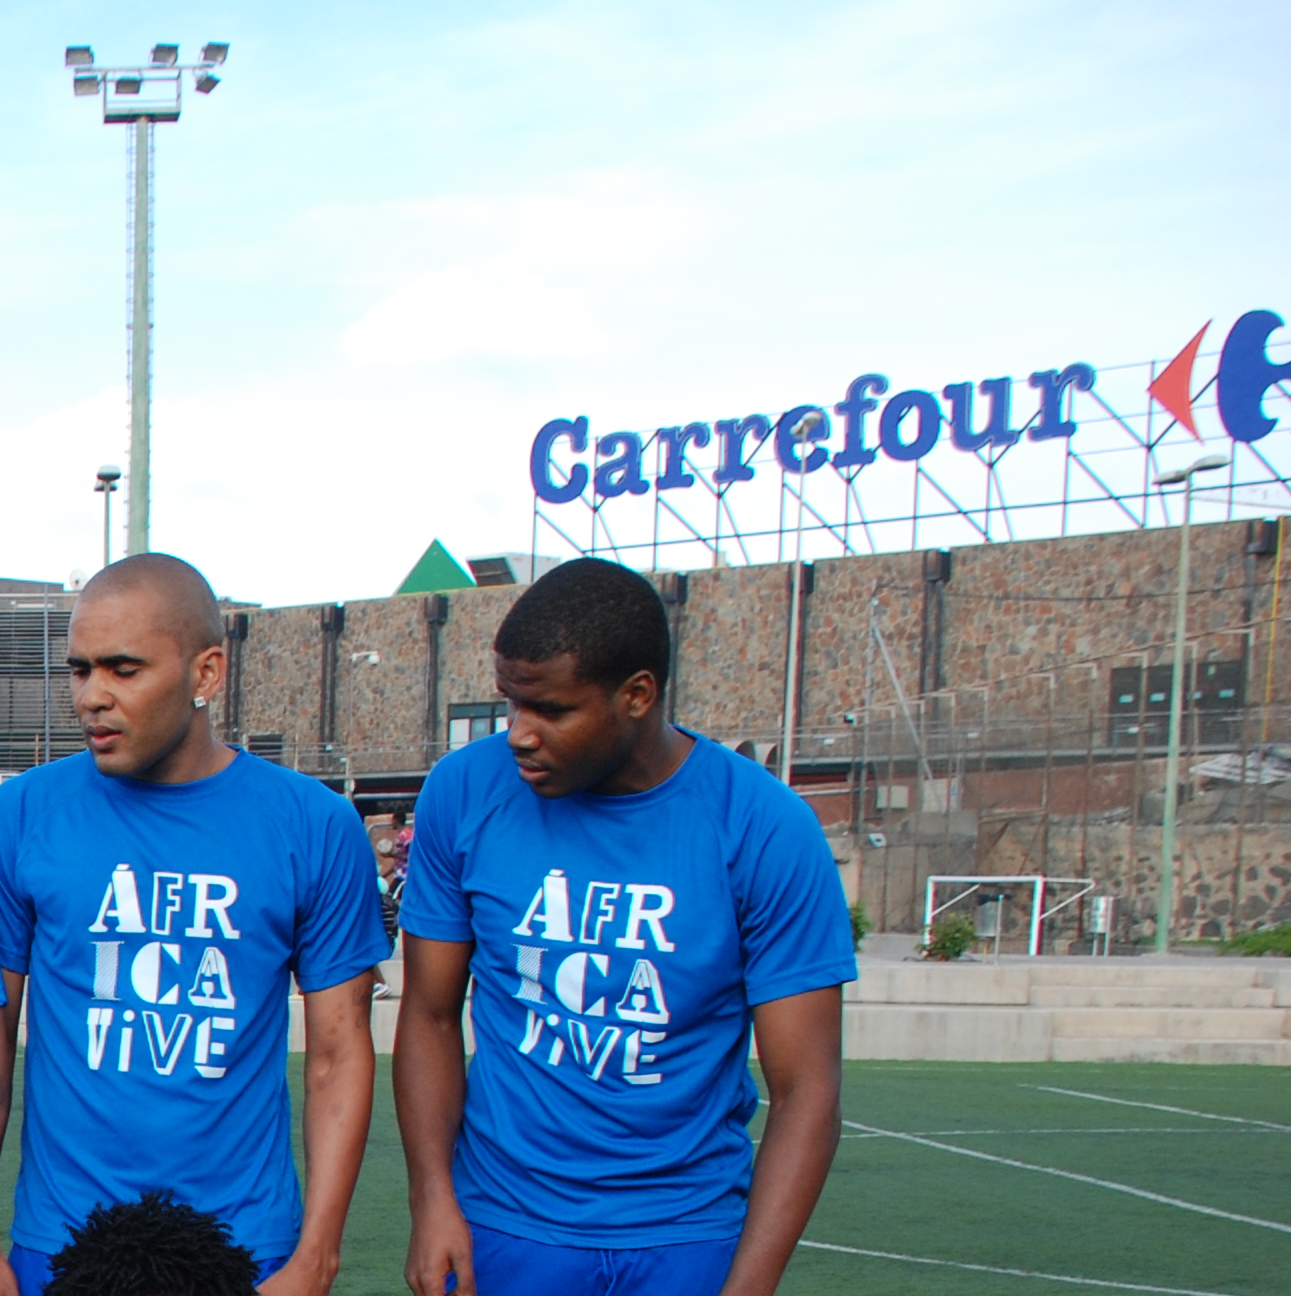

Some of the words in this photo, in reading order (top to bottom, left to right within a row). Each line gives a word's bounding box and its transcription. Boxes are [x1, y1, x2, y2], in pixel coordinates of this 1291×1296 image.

[529, 362, 1096, 504] Carrefour
[88, 941, 235, 1009] ICA
[510, 944, 669, 1024] ICA
